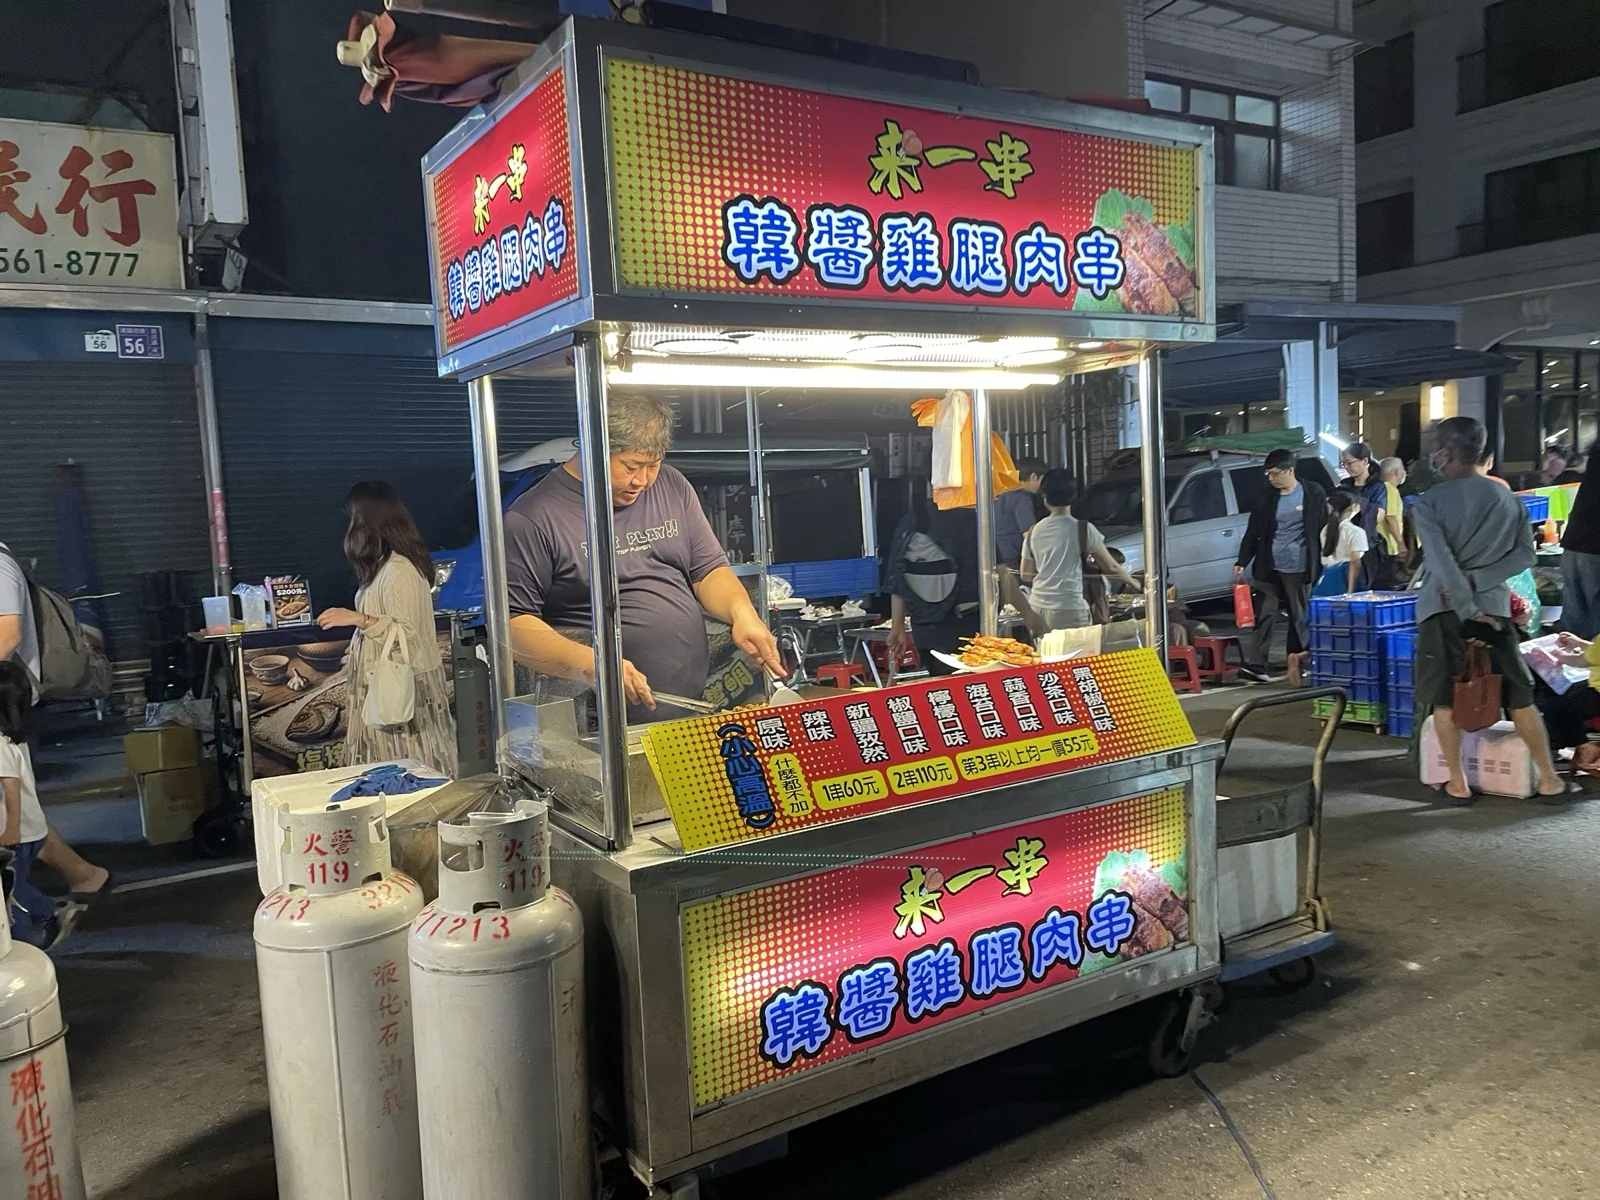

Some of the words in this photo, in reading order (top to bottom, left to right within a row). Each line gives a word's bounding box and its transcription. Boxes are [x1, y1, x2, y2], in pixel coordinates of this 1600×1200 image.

[447, 194, 567, 320] 韓醬雞腿肉串
[721, 194, 1126, 299] 韓醬雞腿肉串
[93, 341, 107, 349] 56
[124, 338, 144, 354] 56
[627, 519, 678, 544] PLAY!!
[927, 688, 970, 747] 檸檬口味
[965, 682, 1006, 739] 海苔口味
[1002, 676, 1042, 732] 蒜香口味
[1038, 670, 1077, 726] 沙茶口味
[1071, 666, 1117, 732] 黑胡椒口味
[756, 717, 792, 750] 原味
[801, 710, 836, 742] 辣味
[844, 702, 889, 764] 新疆孜然
[887, 695, 929, 755] 椒鹽口味
[893, 762, 952, 788] 2串110元
[961, 734, 1094, 776] 第3串以上均一價55元
[775, 757, 809, 813] 什麼都不加
[822, 776, 879, 802] 1串60元
[303, 829, 356, 856] 火警
[504, 831, 545, 862] 火警
[306, 861, 349, 884] 119
[507, 864, 542, 893] 119
[760, 888, 1137, 1069] 韓醬雞腿肉串
